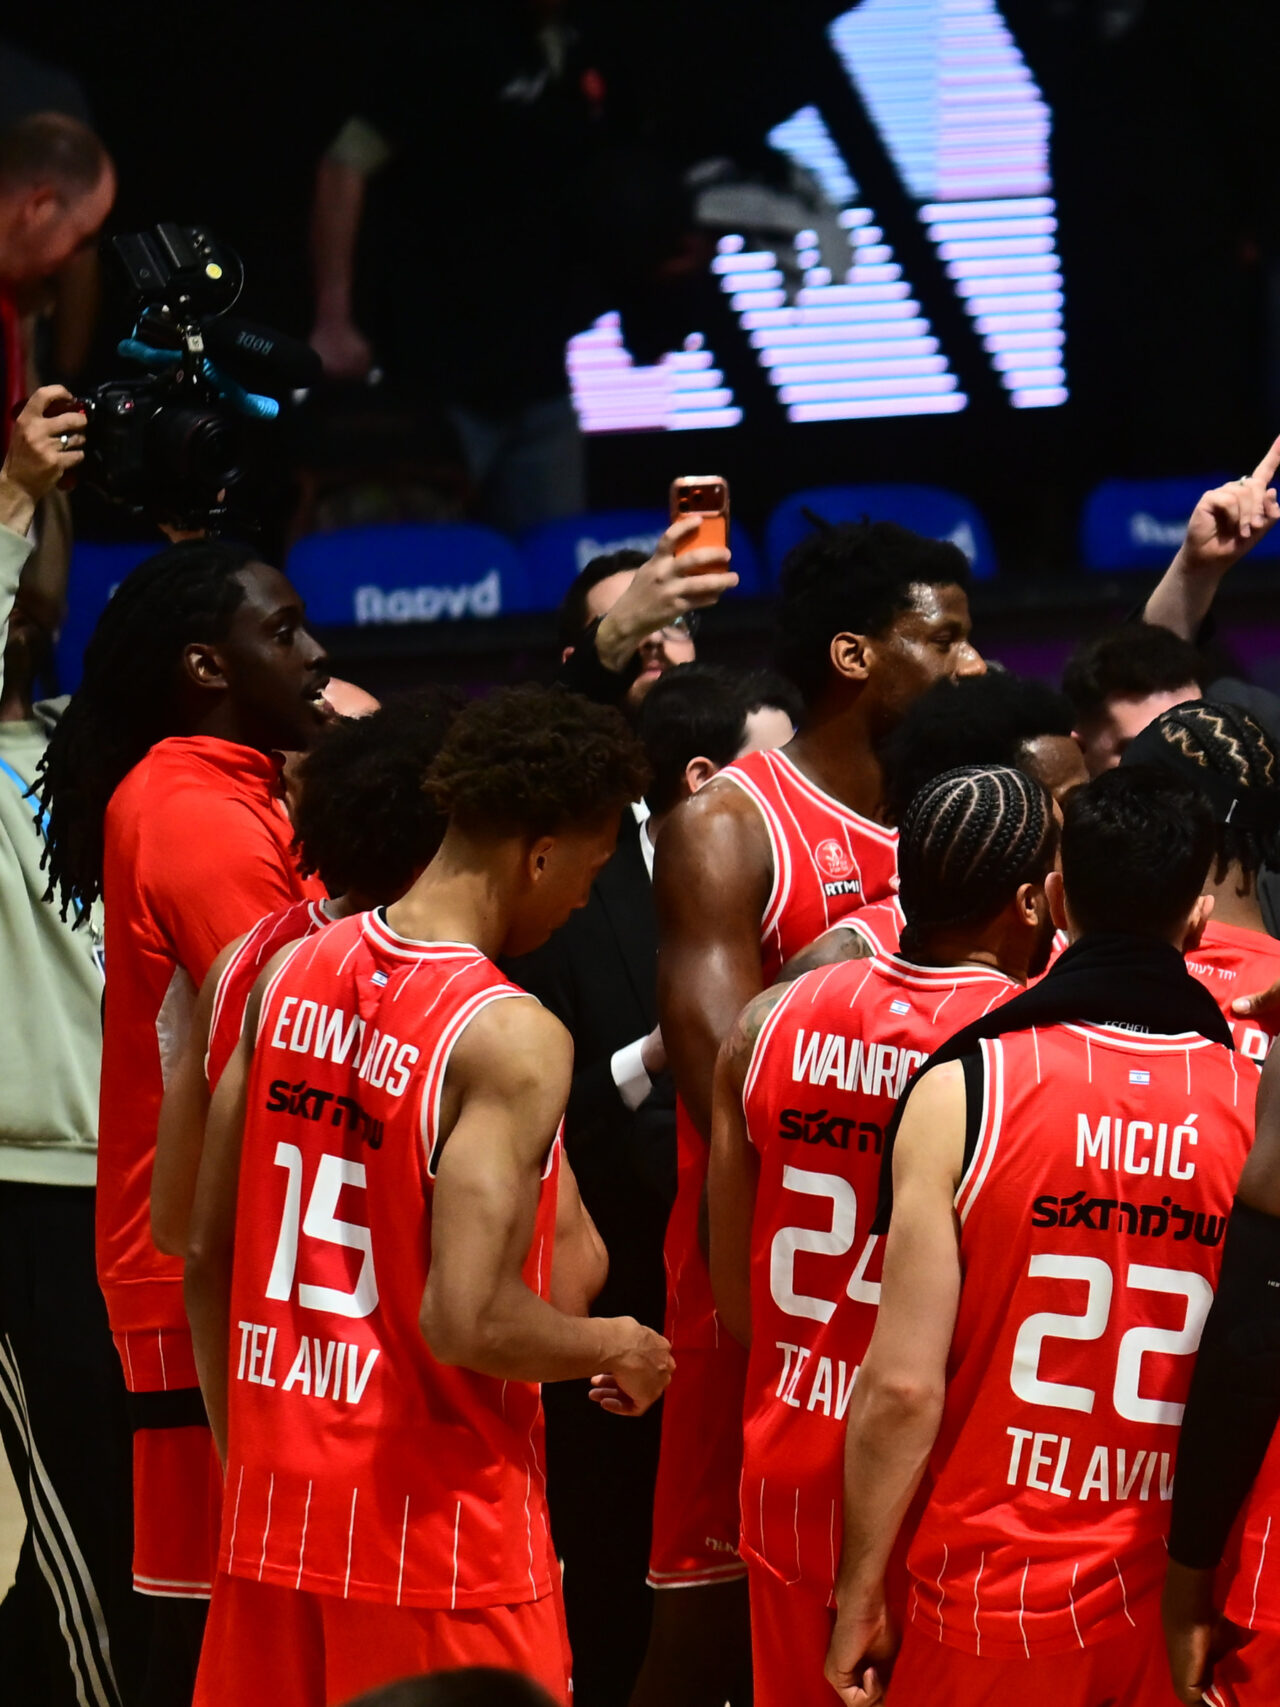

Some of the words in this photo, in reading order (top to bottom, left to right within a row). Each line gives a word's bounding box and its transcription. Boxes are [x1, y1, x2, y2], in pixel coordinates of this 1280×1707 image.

[1076, 1113, 1198, 1181] MICIĆ
[265, 1141, 379, 1319] 15
[236, 1320, 277, 1388] TEL
[281, 1336, 380, 1404] AVIV
[1010, 1254, 1214, 1426] 22
[807, 1356, 861, 1421] AV
[1006, 1426, 1071, 1498] TEL
[1078, 1445, 1175, 1502] AVIV
